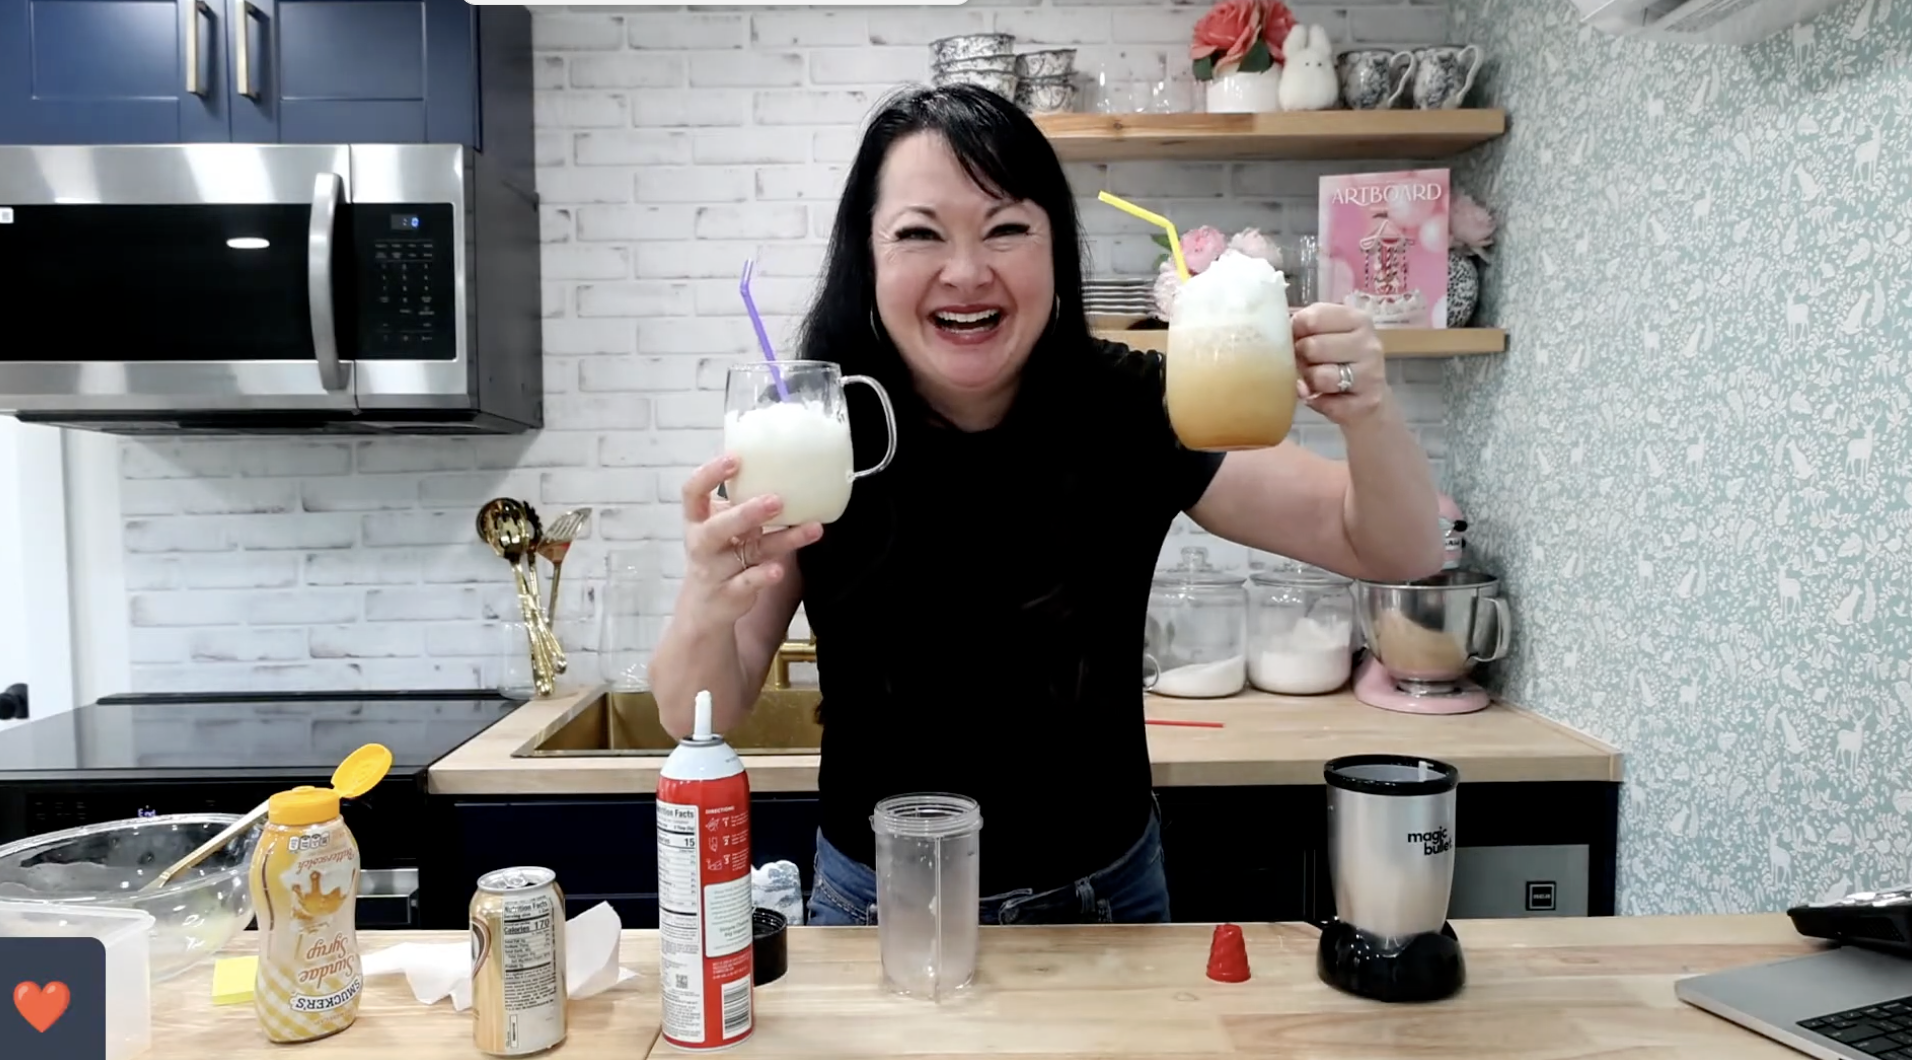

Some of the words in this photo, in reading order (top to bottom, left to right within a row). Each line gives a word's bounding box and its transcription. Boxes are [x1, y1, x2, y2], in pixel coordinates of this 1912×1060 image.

[1332, 183, 1442, 206] ARTBOARD
[674, 809, 695, 818] Facts
[705, 806, 735, 815] DIRECTIONS
[683, 837, 695, 847] 15
[1407, 826, 1448, 844] magic
[1423, 837, 1452, 856] bullet
[297, 848, 356, 874] Butterscotch
[534, 918, 550, 931] 170
[306, 935, 349, 960] Syrup
[299, 955, 355, 989] Sundae
[295, 979, 361, 1011] SMUCKER'S
